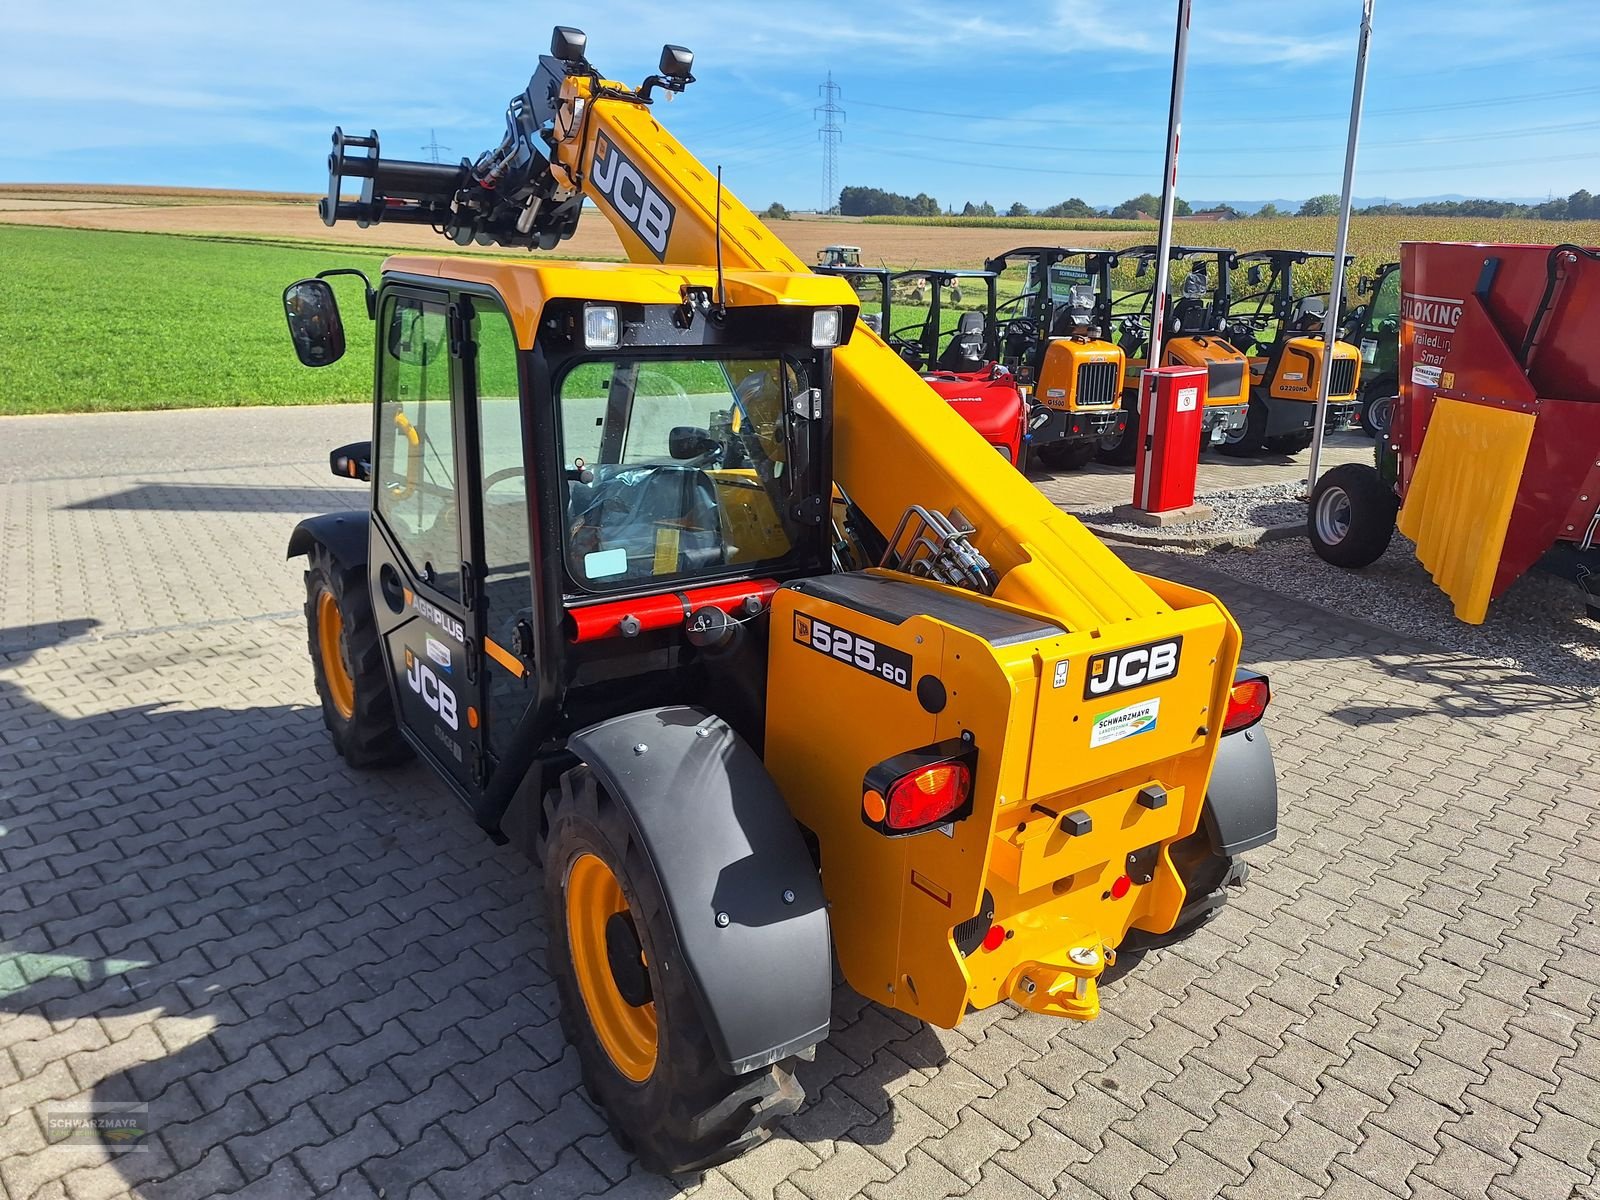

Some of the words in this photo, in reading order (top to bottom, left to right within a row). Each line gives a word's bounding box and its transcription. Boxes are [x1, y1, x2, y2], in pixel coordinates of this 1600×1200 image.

[593, 148, 671, 253] JCB
[1402, 299, 1462, 327] SILOKING
[407, 656, 459, 731] JCB
[1089, 642, 1178, 694] JCB
[1098, 708, 1150, 729] SCHWARZMAYR
